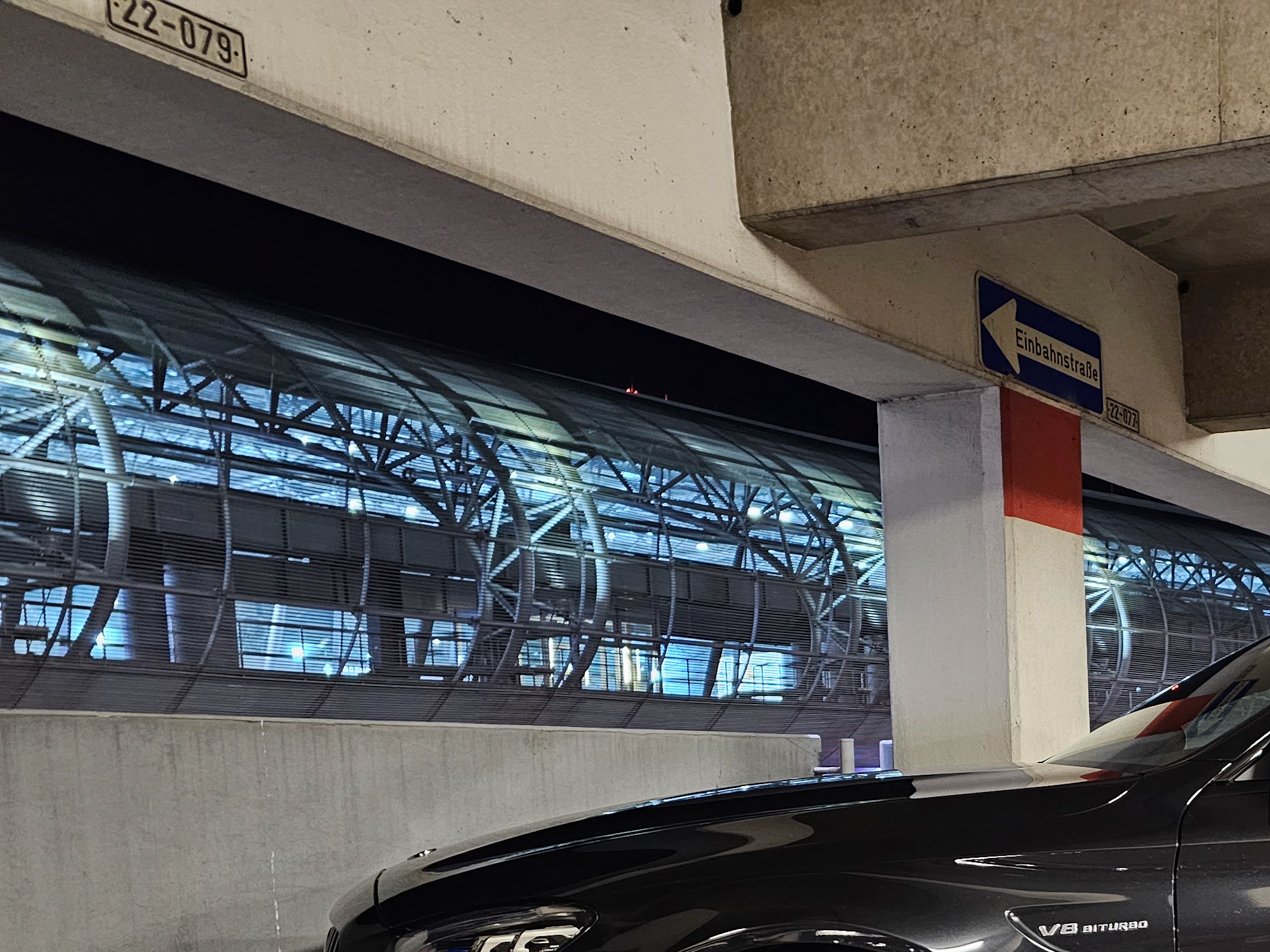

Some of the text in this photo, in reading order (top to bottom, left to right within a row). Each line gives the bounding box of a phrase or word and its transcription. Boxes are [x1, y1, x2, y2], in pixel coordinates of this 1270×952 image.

[122, 0, 232, 64] 22-079
[1015, 327, 1098, 382] Einbahnstraße
[1038, 920, 1149, 936] V8 BITURBO
